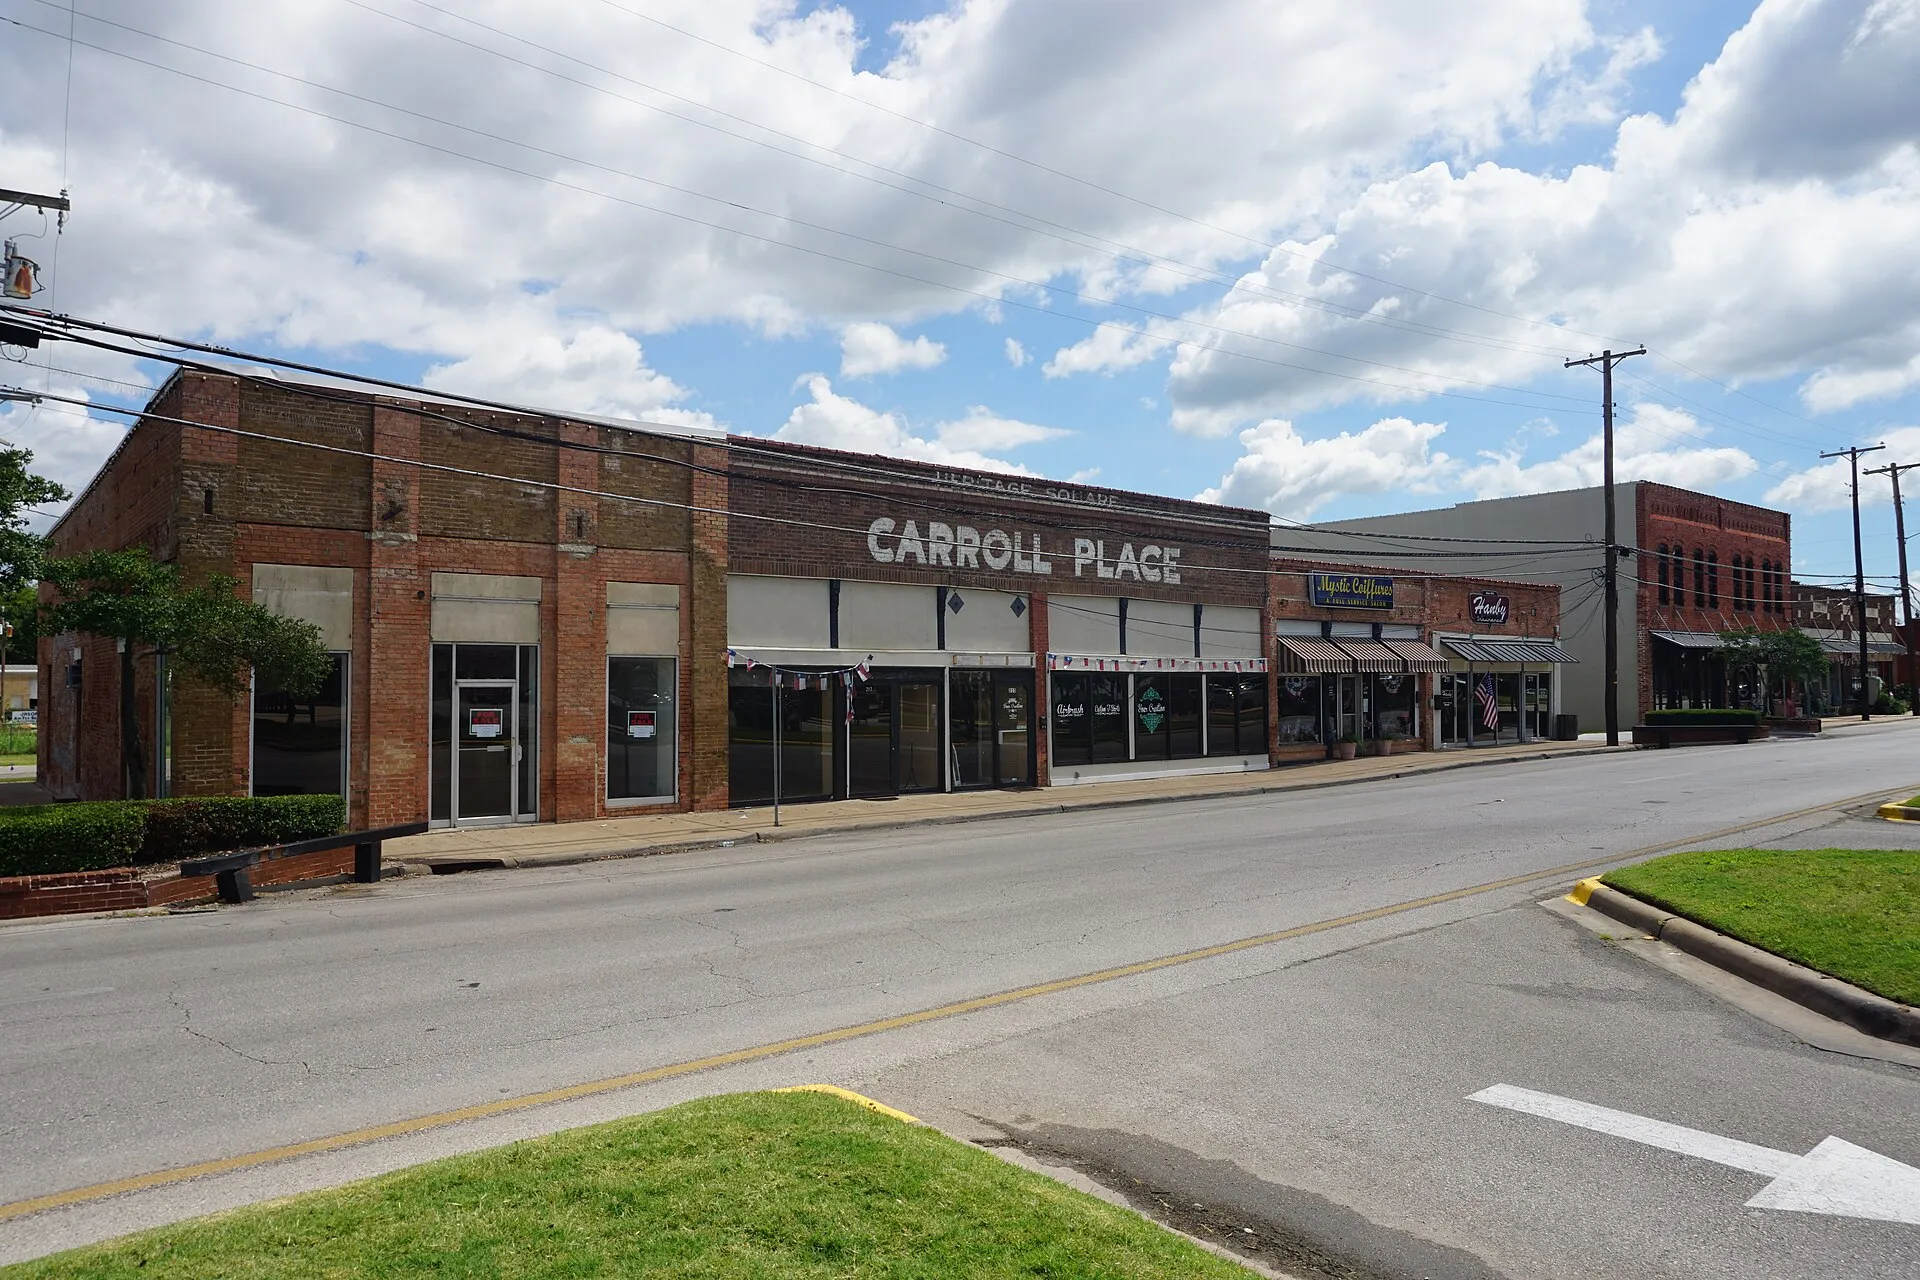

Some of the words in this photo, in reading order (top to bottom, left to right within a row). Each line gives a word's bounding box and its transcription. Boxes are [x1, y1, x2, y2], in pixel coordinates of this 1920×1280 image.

[867, 517, 1052, 574] CARROLL
[1074, 537, 1181, 584] PLACE
[1318, 576, 1350, 596] Mystic
[1352, 577, 1393, 600] Coiffures
[1473, 596, 1507, 621] Hanby
